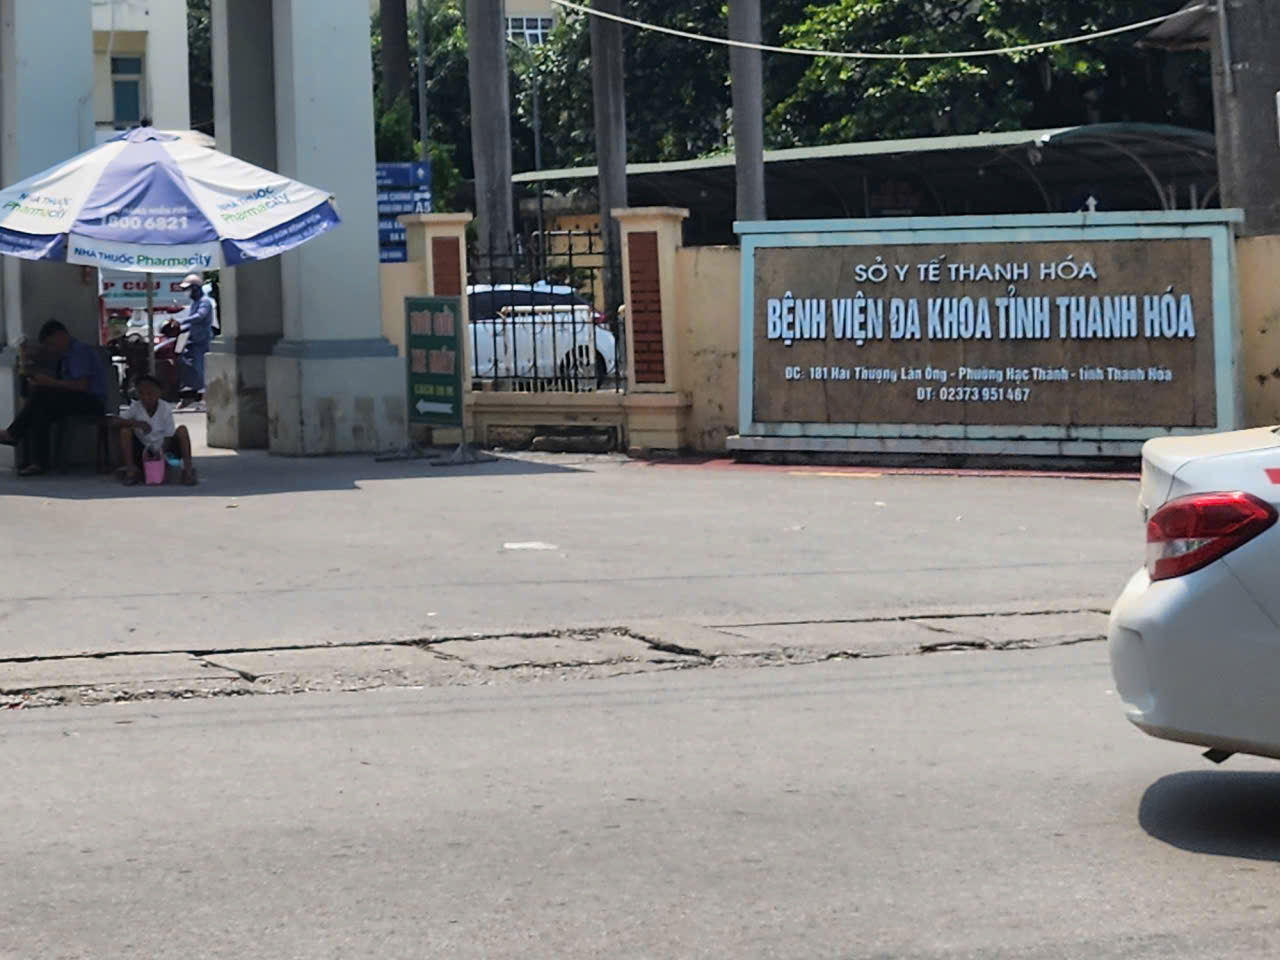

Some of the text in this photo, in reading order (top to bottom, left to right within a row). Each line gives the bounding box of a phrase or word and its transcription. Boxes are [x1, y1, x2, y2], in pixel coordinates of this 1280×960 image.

[143, 216, 188, 230] 6821
[136, 253, 211, 267] Pharmacity
[854, 253, 1098, 282] SỞ Y TẾ THANH HÓA
[767, 284, 1196, 346] BỆNH VIỆN ĐA KHOA TỈNH THANH HÓA
[1106, 366, 1144, 380] Thanh
[940, 387, 979, 401] 02373
